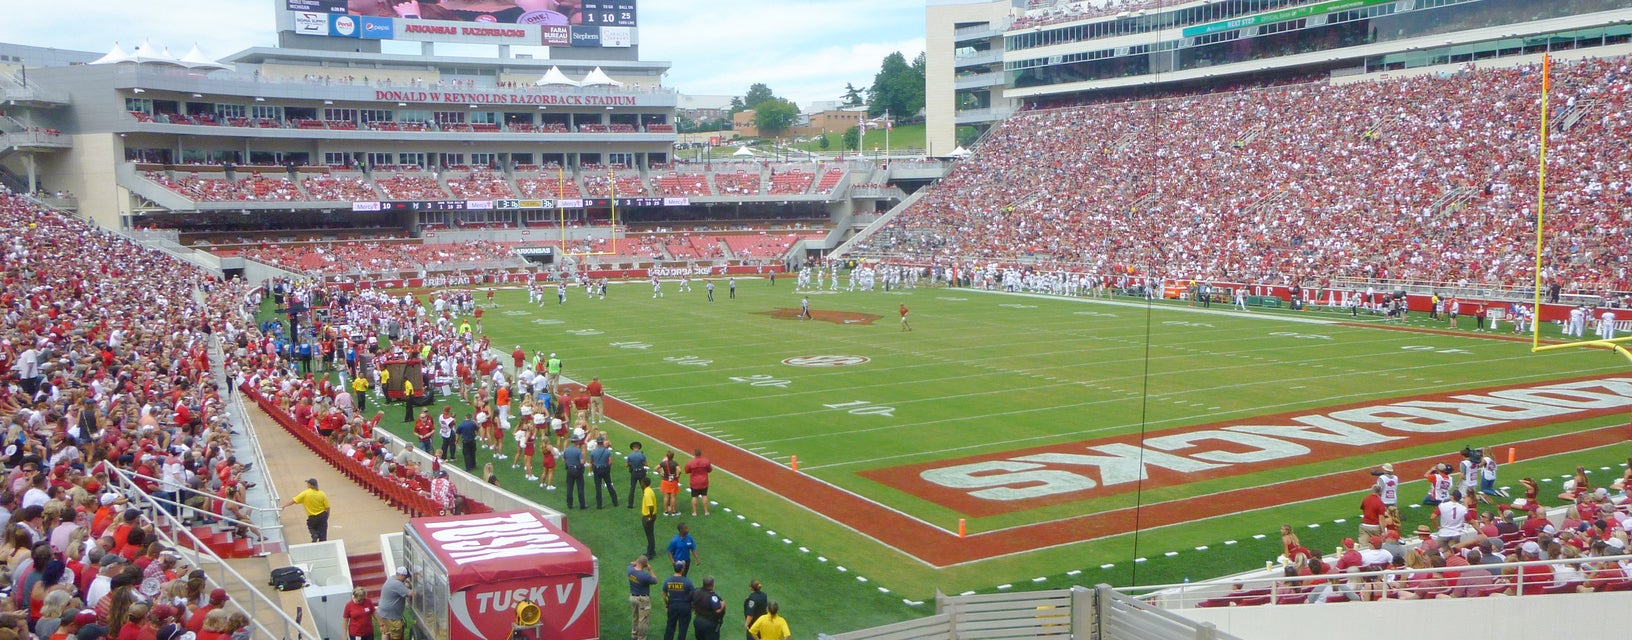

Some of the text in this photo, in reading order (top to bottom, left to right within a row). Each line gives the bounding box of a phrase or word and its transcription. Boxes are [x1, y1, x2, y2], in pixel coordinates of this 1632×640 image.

[588, 13, 594, 22] 1
[602, 14, 615, 22] 10
[1241, 18, 1255, 26] STEP
[405, 24, 525, 37] ARKANSAS RAZORBACKS
[573, 32, 599, 40] Stephens
[376, 90, 636, 106] DONALD W REYNOLDS RAZORBACK STADIUM
[822, 400, 897, 416] 10
[1452, 507, 1458, 520] 1
[424, 511, 579, 566] TUSK
[476, 583, 574, 614] TUSK V
